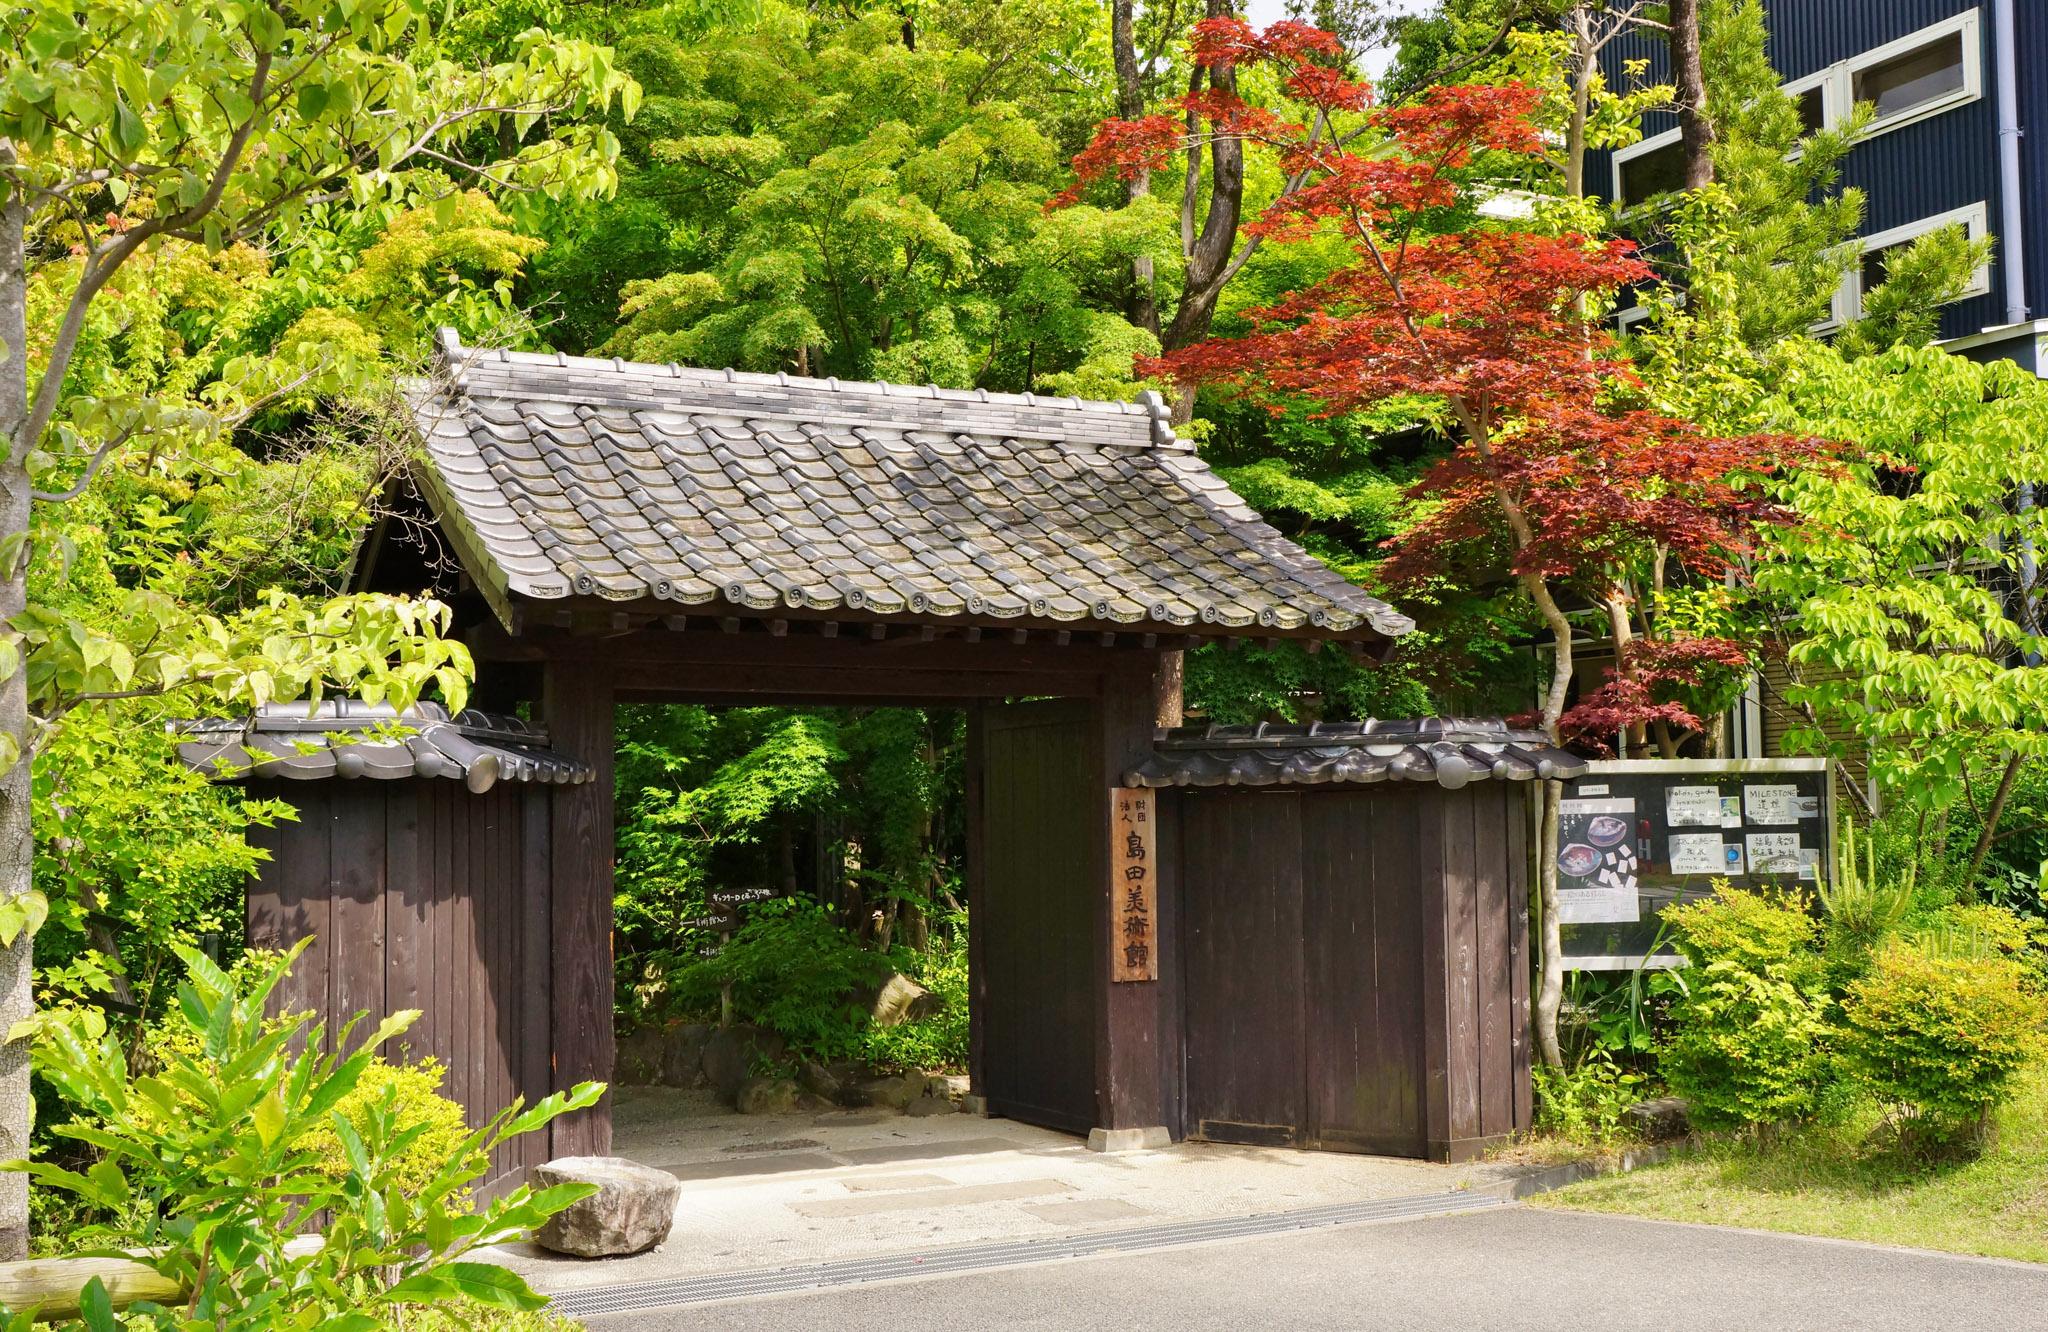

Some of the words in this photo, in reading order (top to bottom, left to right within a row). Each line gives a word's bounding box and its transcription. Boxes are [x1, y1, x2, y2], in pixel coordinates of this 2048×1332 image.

[1750, 789, 1796, 798] MILESTONE
[1123, 831, 1149, 967] 島田美術館
